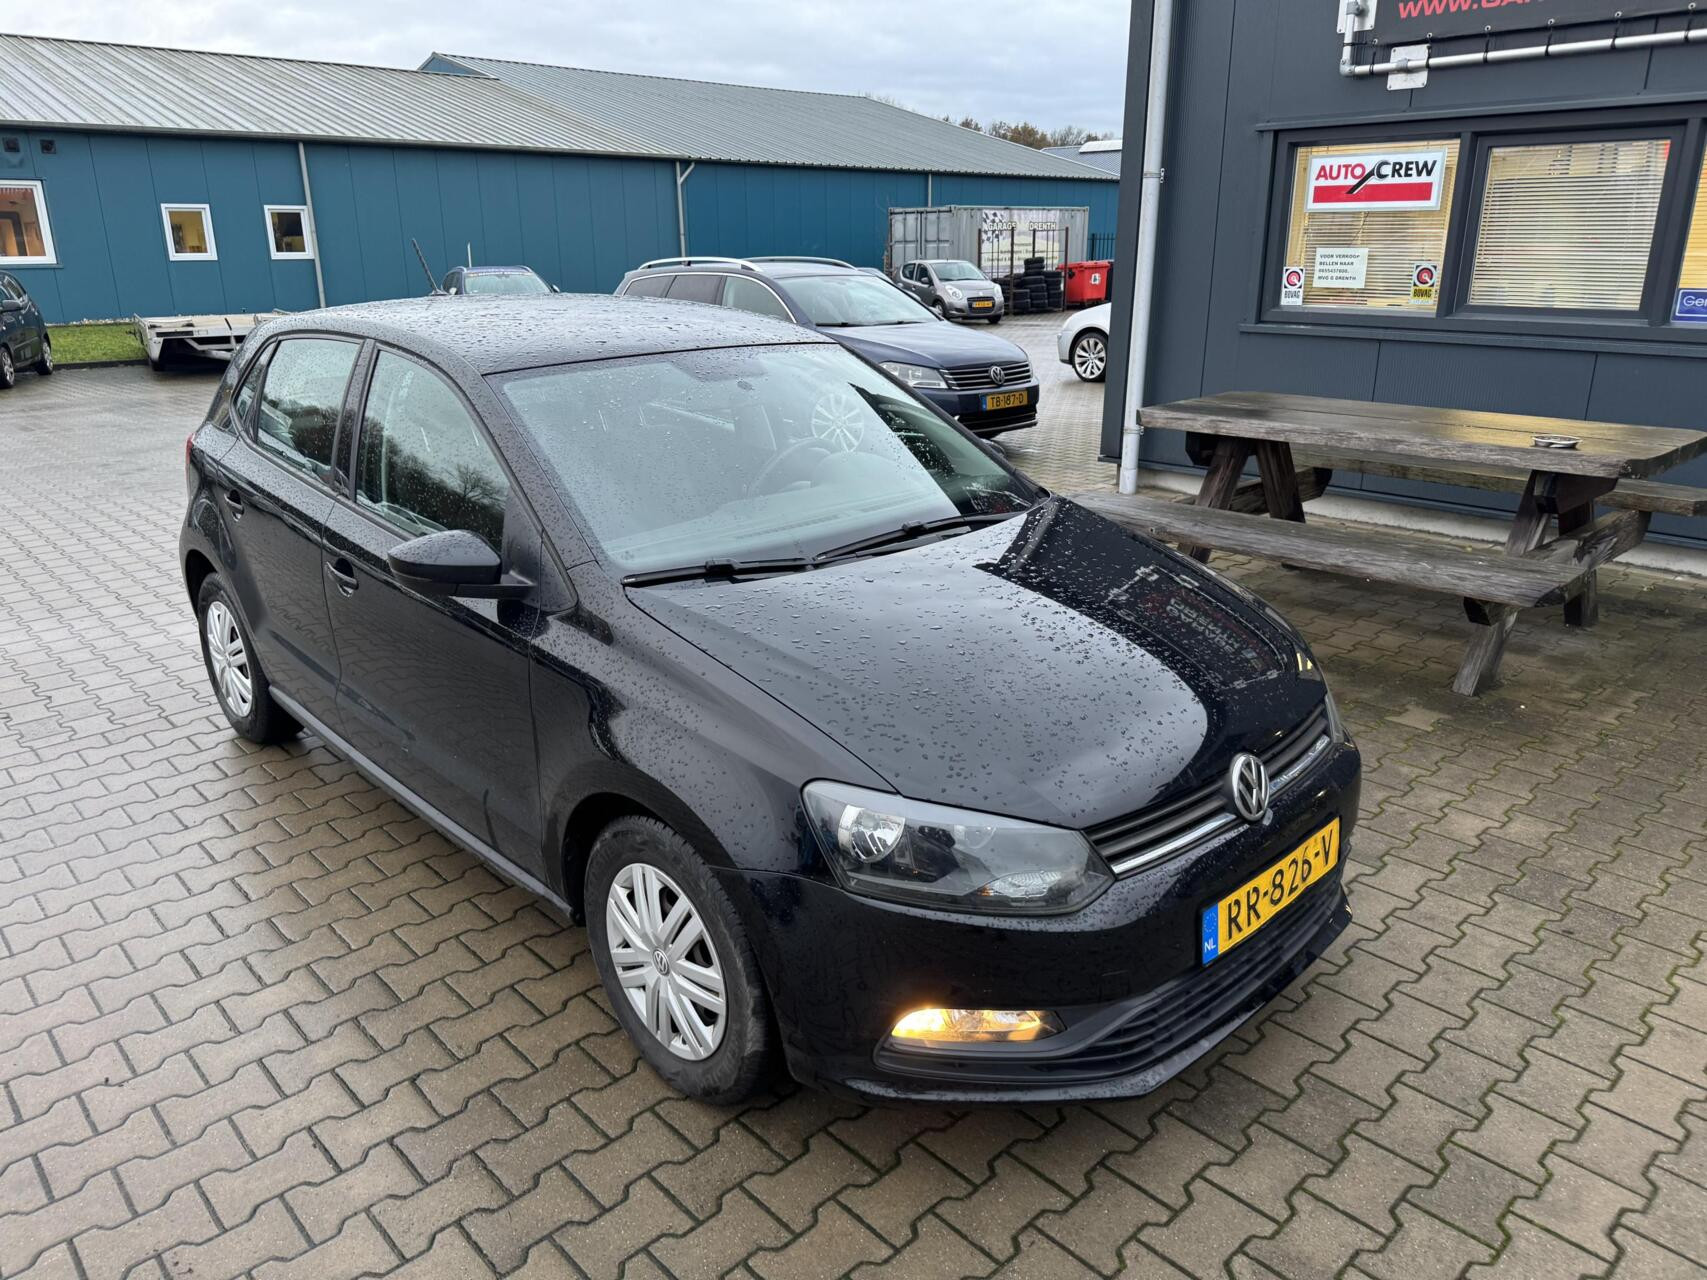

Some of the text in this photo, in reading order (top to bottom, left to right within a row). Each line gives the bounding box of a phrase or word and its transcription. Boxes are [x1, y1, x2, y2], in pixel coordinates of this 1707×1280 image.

[1315, 159, 1437, 181] AUTO CREW
[1029, 222, 1057, 231] DRENTH
[1284, 290, 1301, 299] BOVAG
[1413, 288, 1432, 298] BOVAG
[1227, 829, 1333, 940] RR-826-V
[1204, 939, 1217, 952] NL
